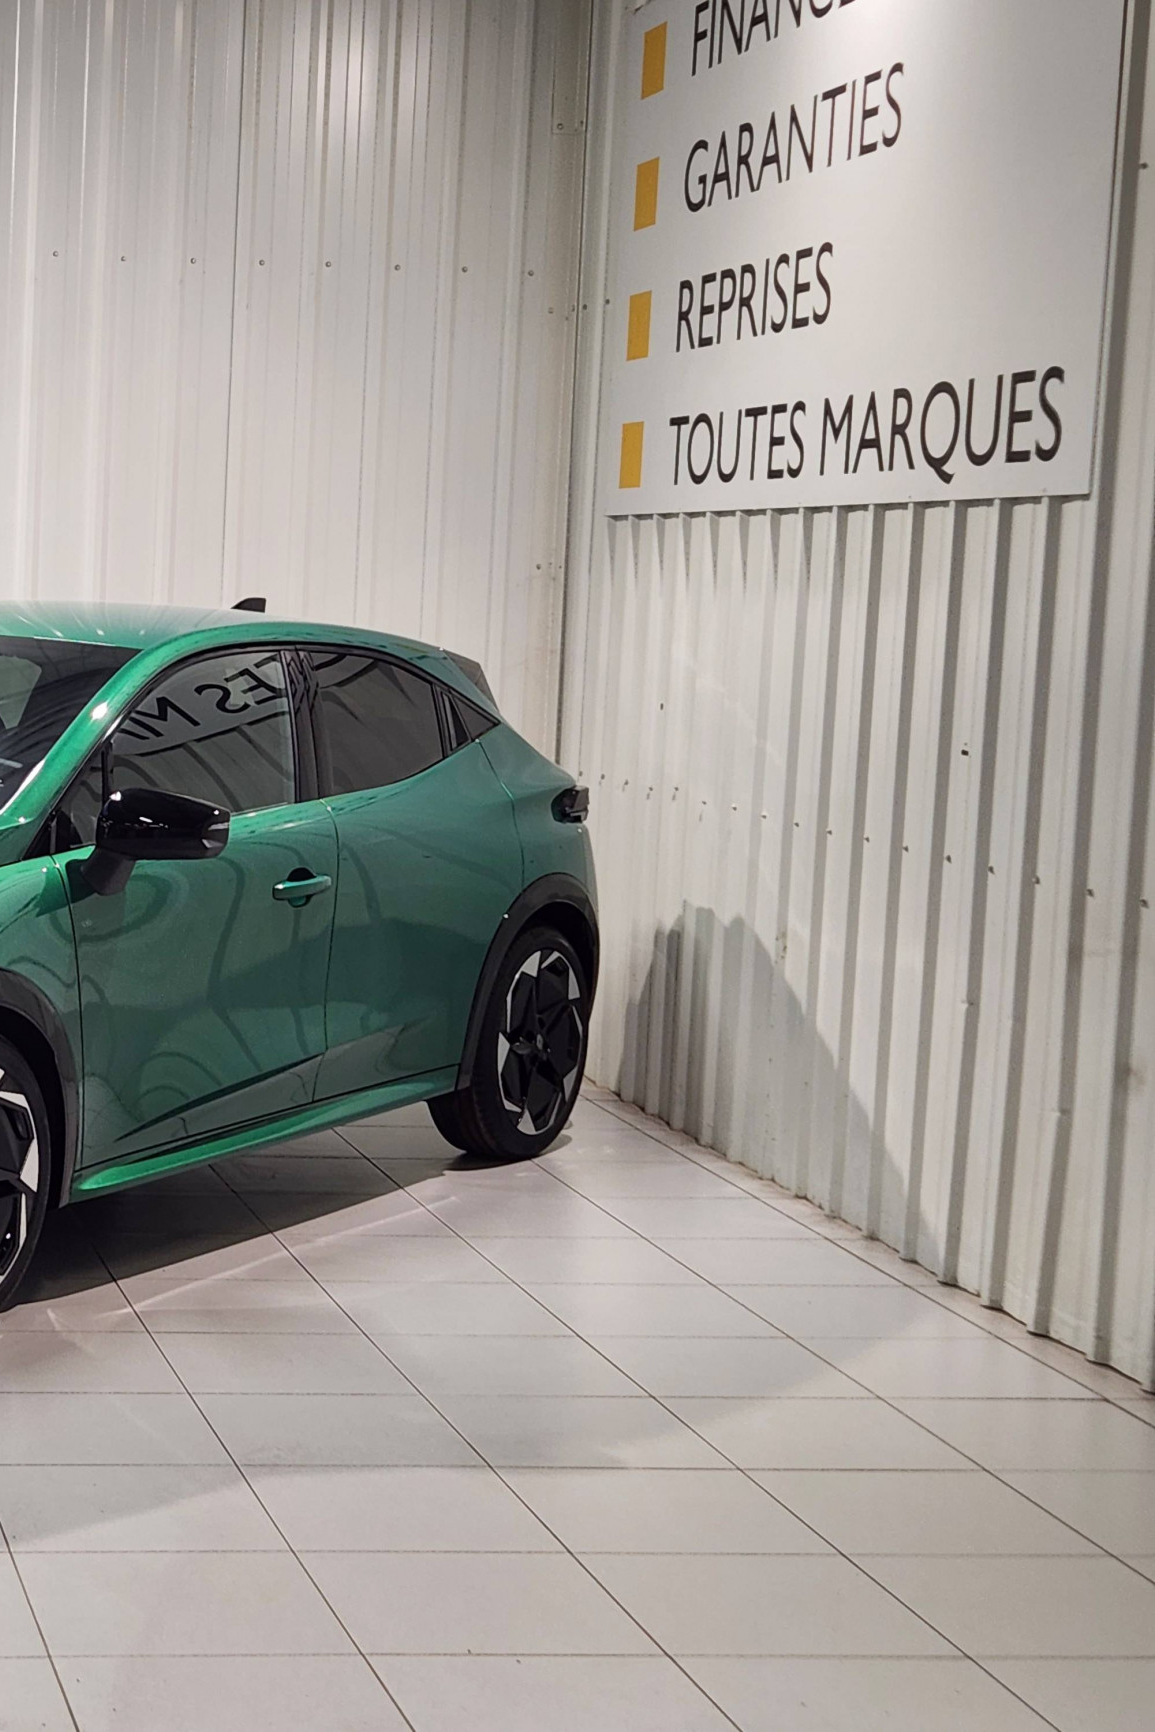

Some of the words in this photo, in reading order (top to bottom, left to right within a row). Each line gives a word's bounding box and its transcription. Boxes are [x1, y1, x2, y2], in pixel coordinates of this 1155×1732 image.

[685, 62, 904, 212] GARANTIES
[676, 243, 834, 352] REPRISES
[670, 401, 806, 485] TOUTES
[820, 366, 1065, 484] MARQUES
